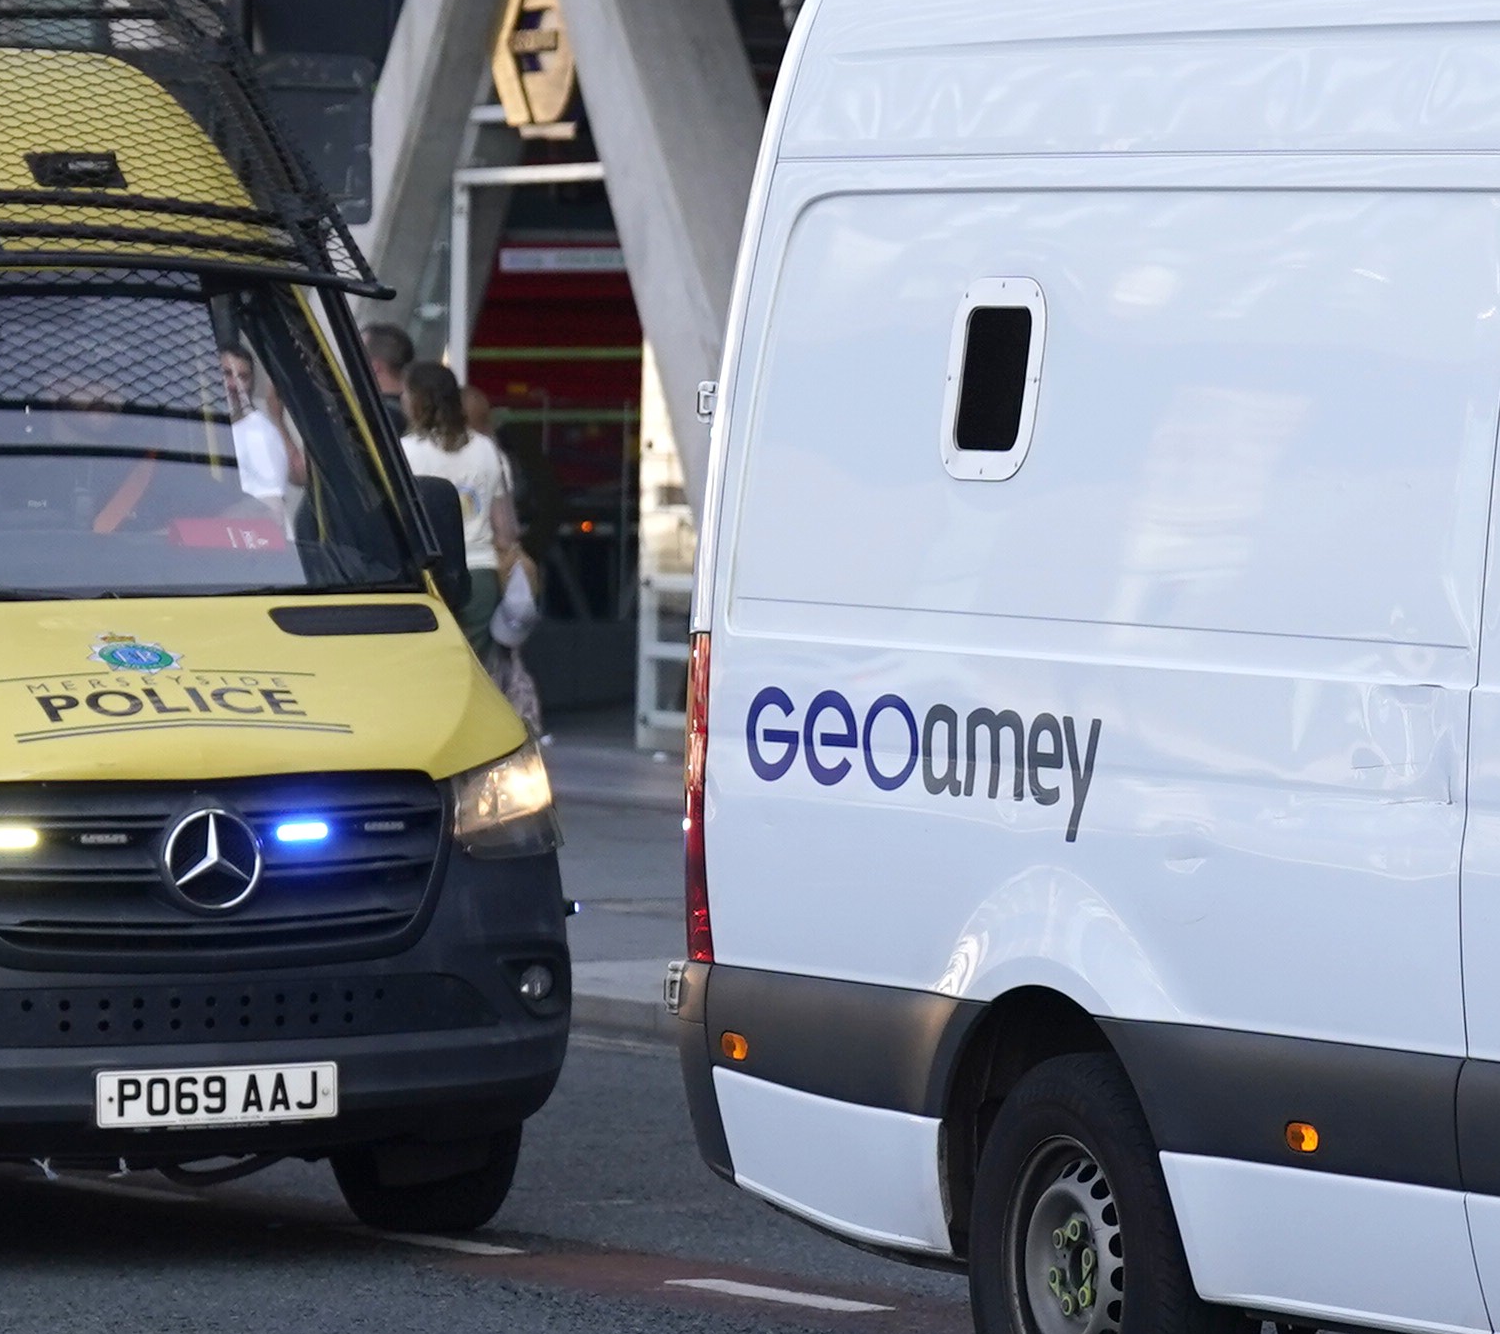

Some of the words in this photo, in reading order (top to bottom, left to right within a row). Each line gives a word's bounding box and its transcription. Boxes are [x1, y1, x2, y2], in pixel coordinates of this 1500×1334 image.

[26, 674, 288, 695] MERSEYSIDE
[36, 687, 308, 723] POLICE
[117, 1075, 227, 1118] PO69
[241, 1070, 319, 1113] AAJ
